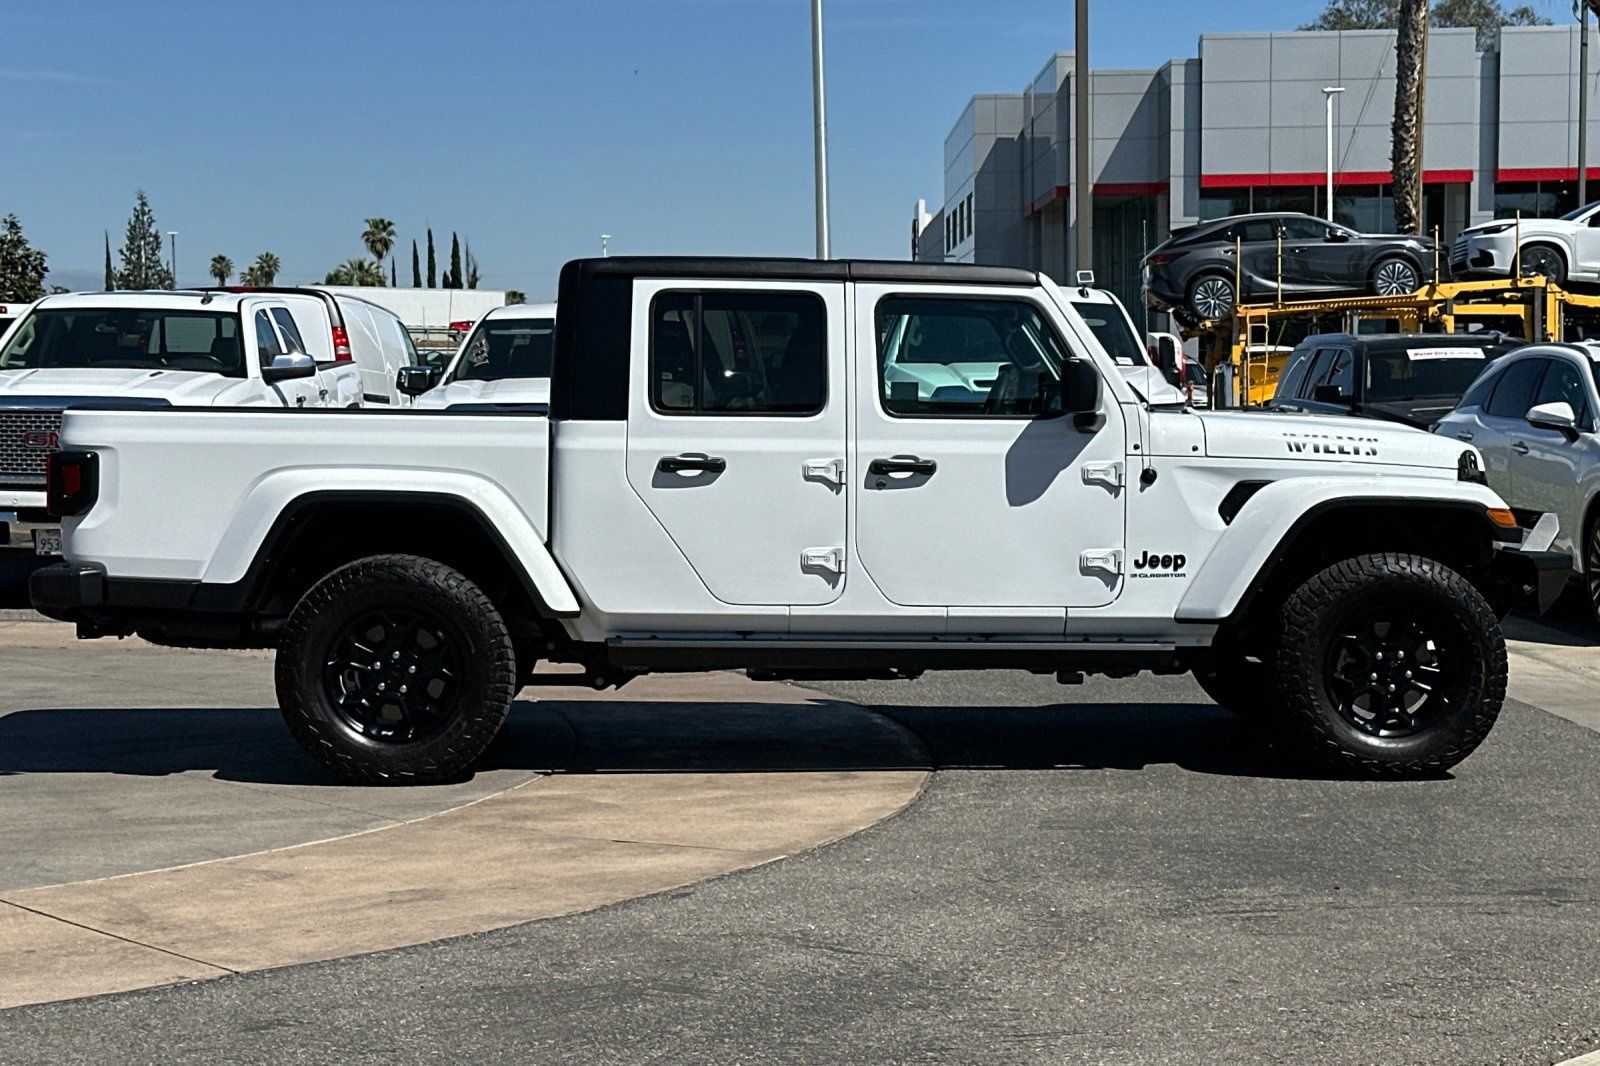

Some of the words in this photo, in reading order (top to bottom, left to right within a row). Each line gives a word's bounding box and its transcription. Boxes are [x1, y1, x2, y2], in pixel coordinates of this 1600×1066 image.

[1282, 433, 1378, 456] WILLYS
[40, 538, 62, 552] 953
[1133, 550, 1186, 572] Jeep
